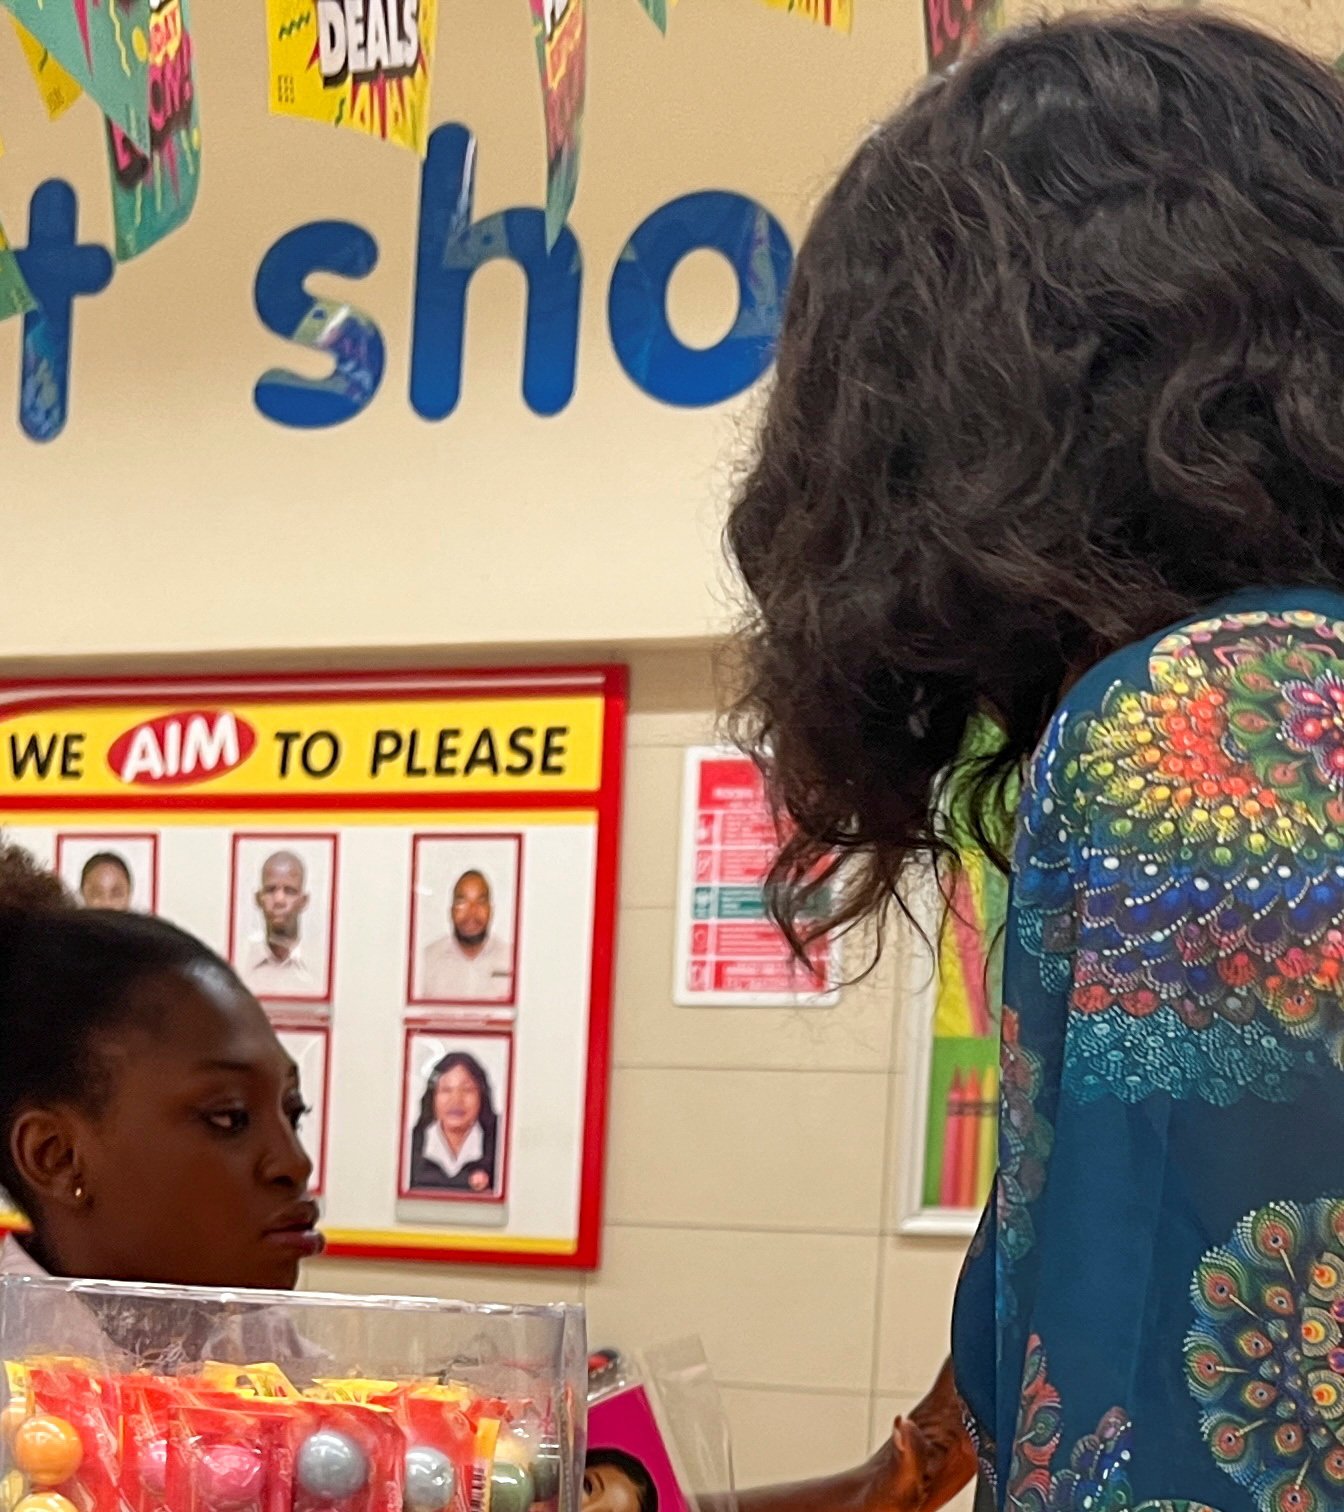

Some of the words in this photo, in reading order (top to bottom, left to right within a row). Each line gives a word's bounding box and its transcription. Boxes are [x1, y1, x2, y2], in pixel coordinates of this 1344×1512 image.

[318, 0, 419, 78] DEALS
[8, 732, 86, 780] WE
[121, 712, 241, 784] AIM
[274, 729, 342, 779] TO
[370, 725, 572, 779] PLEASE
